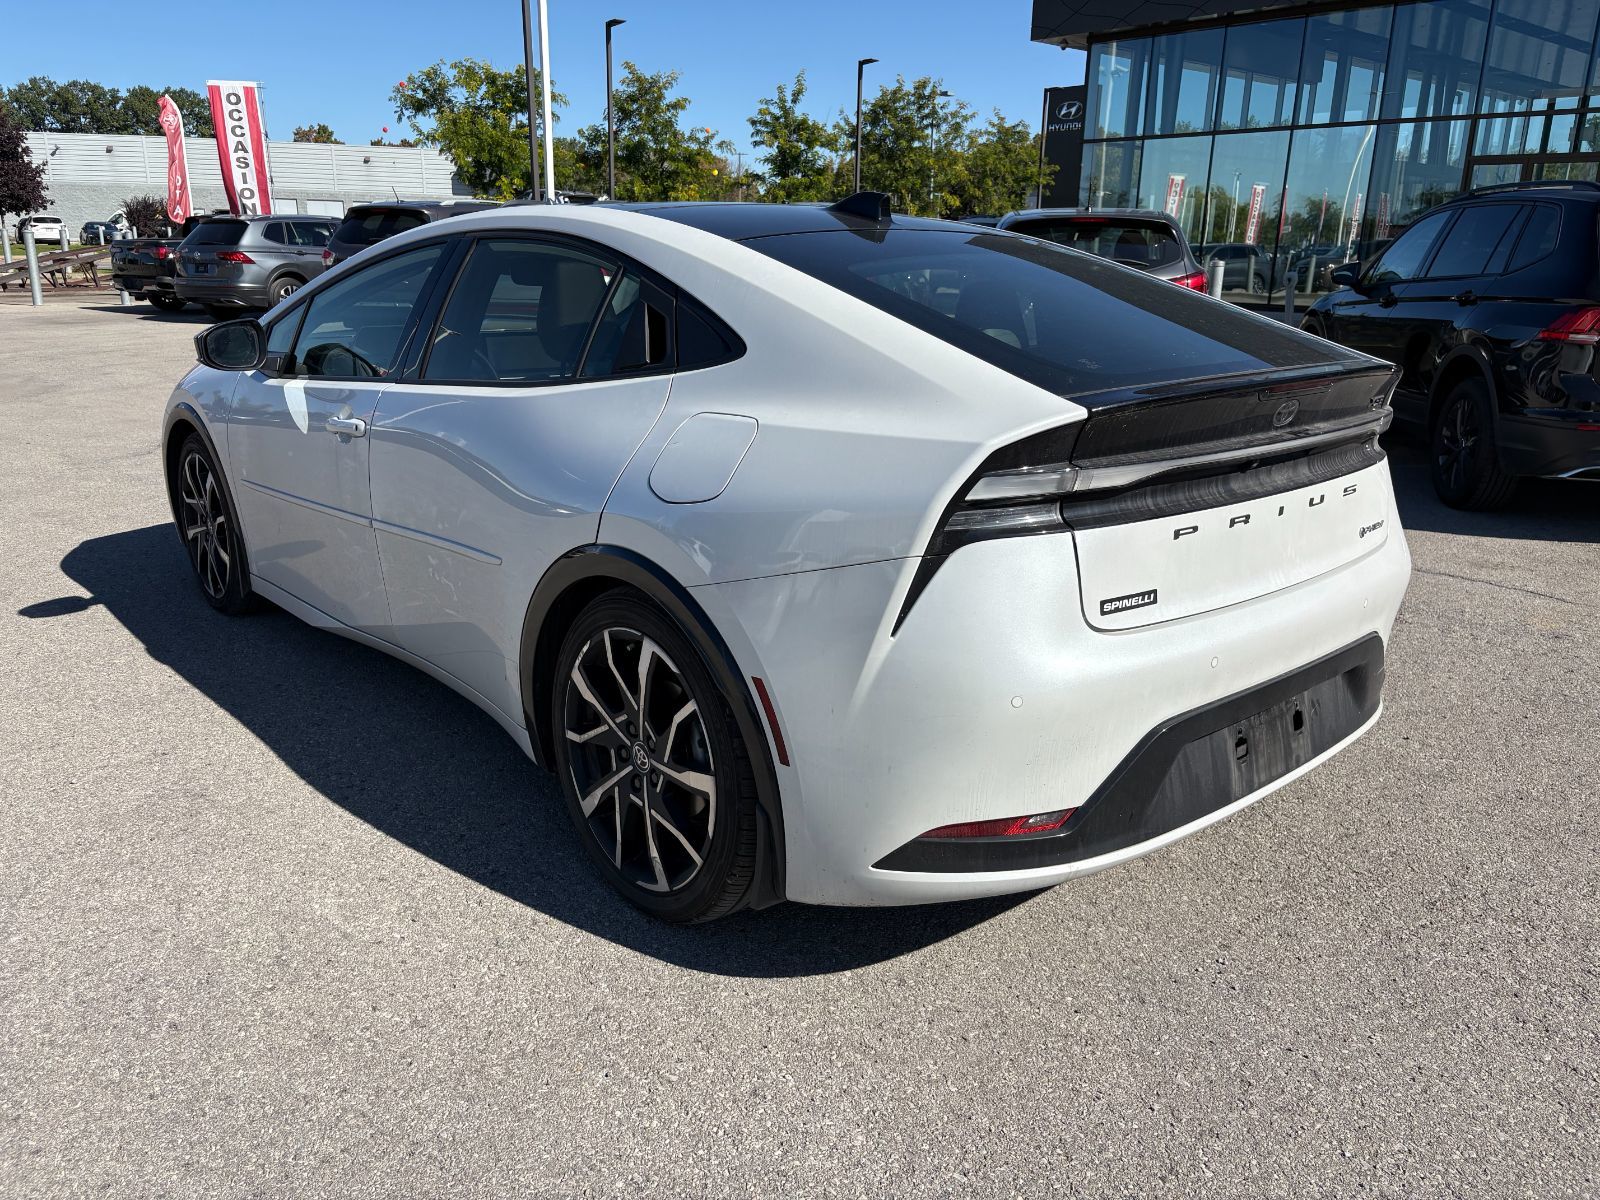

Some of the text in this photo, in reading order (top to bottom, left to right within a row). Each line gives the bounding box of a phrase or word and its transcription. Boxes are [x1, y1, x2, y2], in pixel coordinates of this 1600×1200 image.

[225, 92, 258, 215] OCCASION
[1173, 484, 1358, 541] PRIUS
[1103, 593, 1155, 612] SPINELLI
